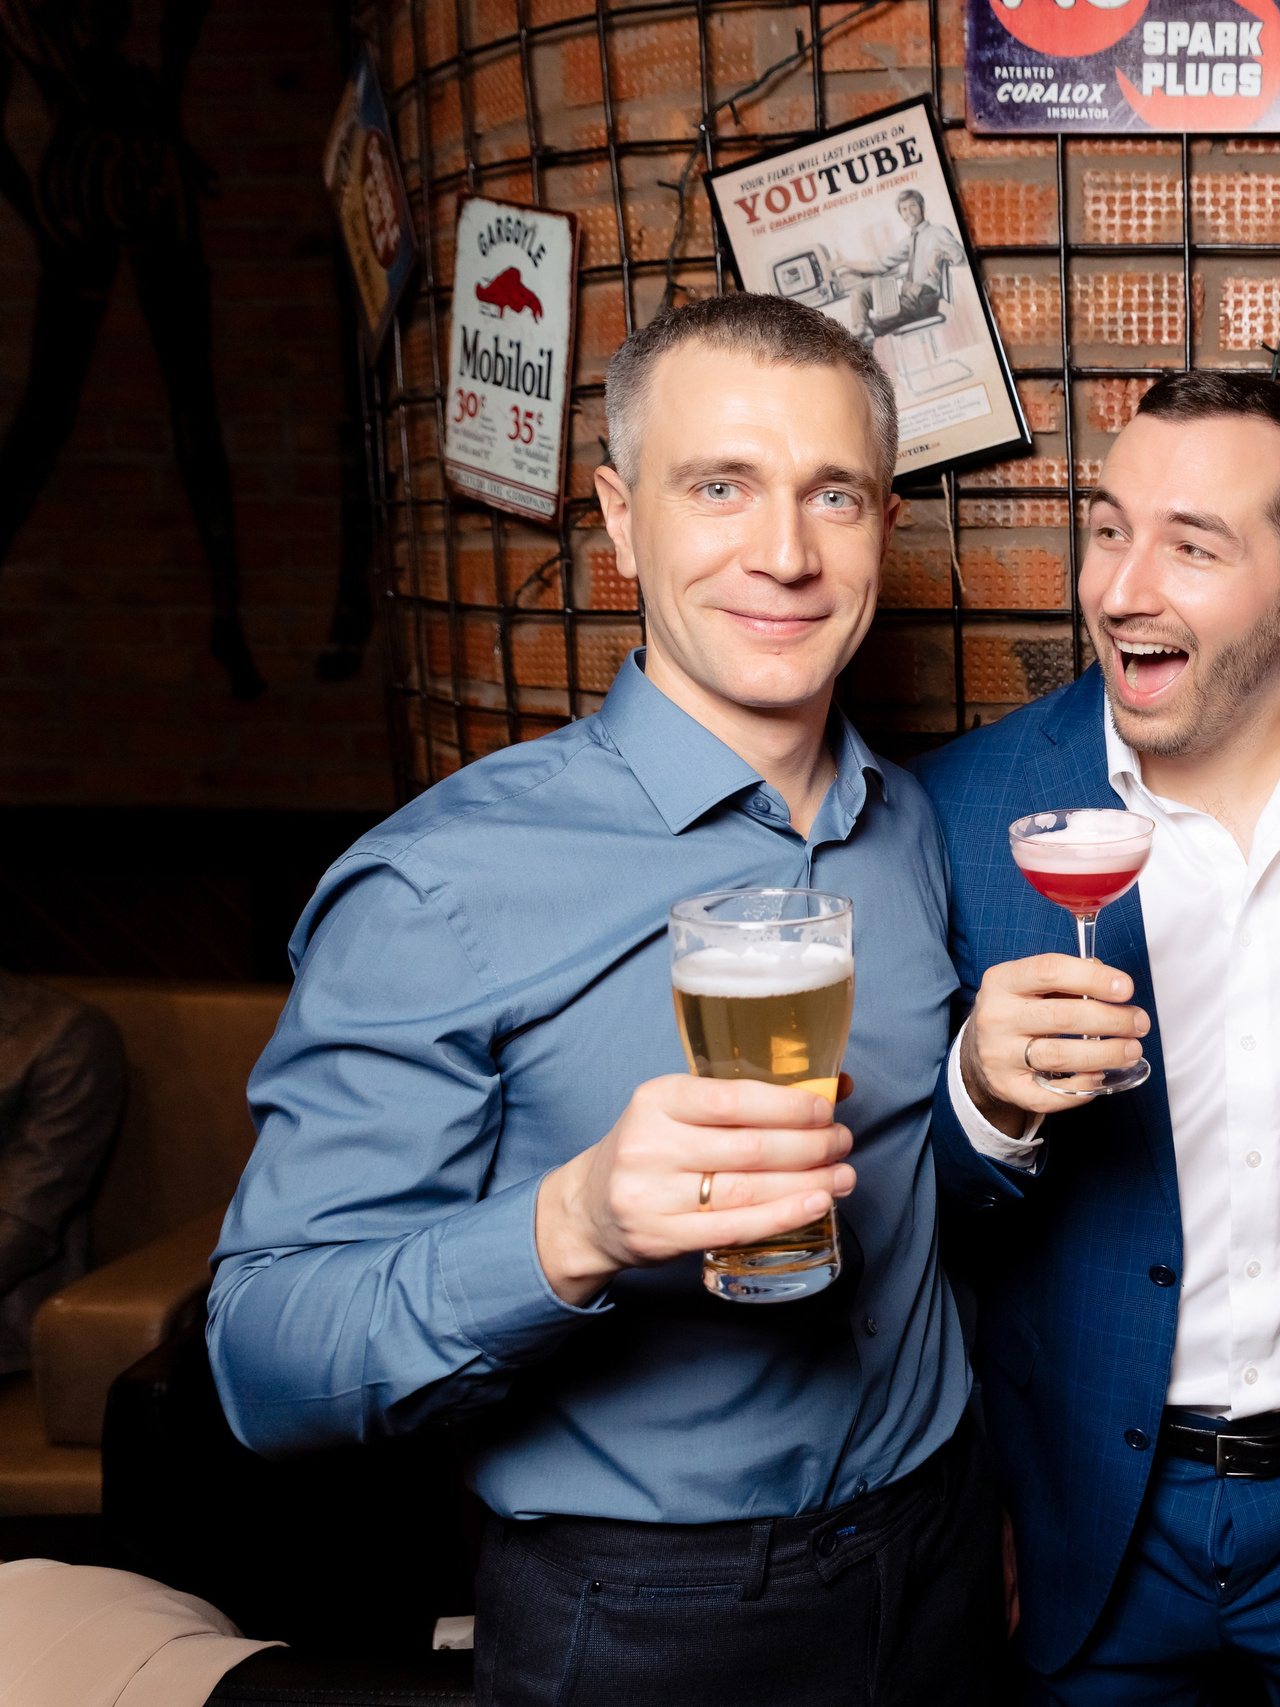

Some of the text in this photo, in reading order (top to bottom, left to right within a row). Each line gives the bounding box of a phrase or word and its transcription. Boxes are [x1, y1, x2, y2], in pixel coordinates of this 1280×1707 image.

[1143, 21, 1264, 57] SPARK
[994, 66, 1054, 80] PATENTED
[996, 82, 1106, 104] CORALOX
[1141, 62, 1263, 98] PLUGS
[1047, 107, 1109, 120] INSULATOR
[740, 124, 906, 193] YOUR FILMS WILL LAST FOREVER ON
[734, 137, 924, 225] YOUTUBE
[769, 207, 820, 232] CHAMPION
[861, 186, 874, 199] ON
[478, 216, 547, 268] GARGOYLE
[458, 325, 552, 401] Mobiloil
